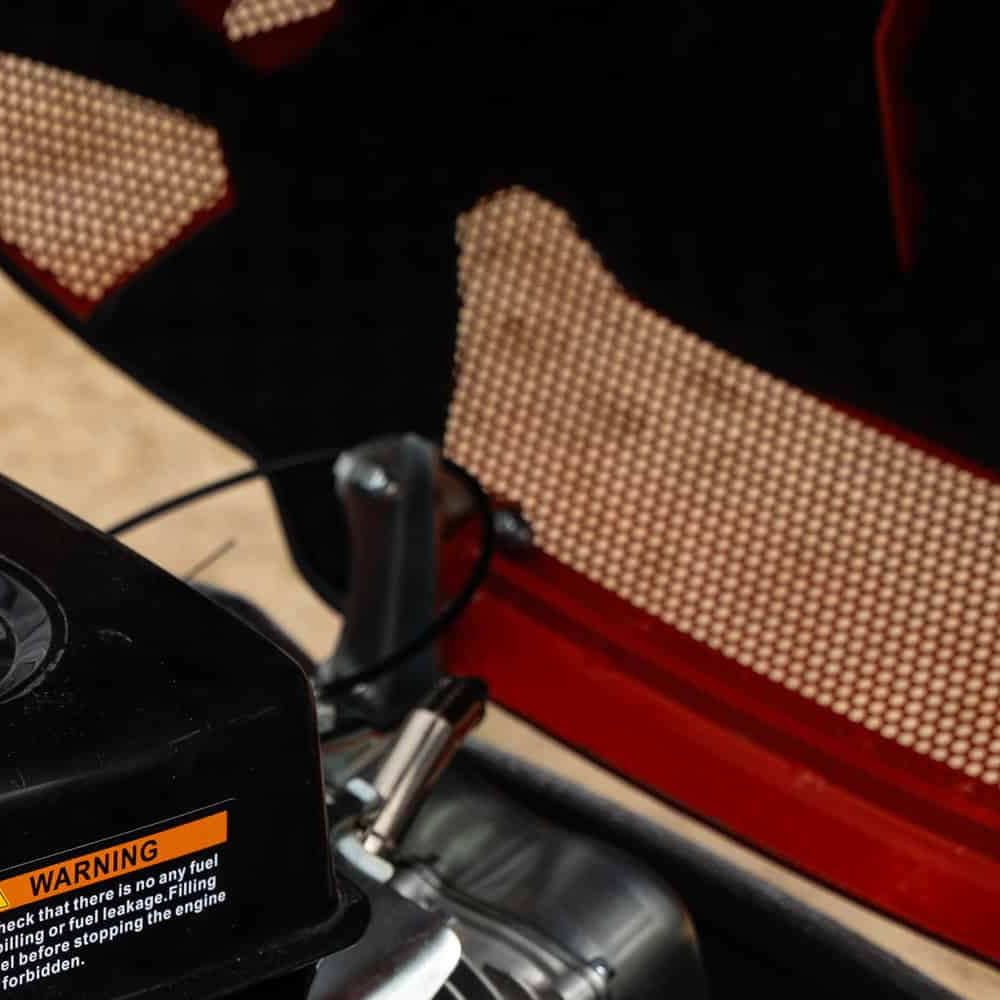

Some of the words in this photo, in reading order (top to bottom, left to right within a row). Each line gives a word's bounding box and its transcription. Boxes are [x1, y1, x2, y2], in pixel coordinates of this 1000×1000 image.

[30, 840, 157, 896] WARNING
[38, 901, 70, 922] that
[73, 889, 114, 911] there
[118, 883, 131, 897] is
[136, 877, 155, 892] no
[159, 866, 186, 884] any
[190, 853, 218, 875] fuel
[19, 941, 70, 966] before
[74, 917, 143, 948] stopping
[147, 909, 171, 925] the
[175, 891, 226, 916] engine
[48, 923, 65, 937] or
[69, 909, 98, 931] fuel
[2, 956, 85, 990] forbidden.
